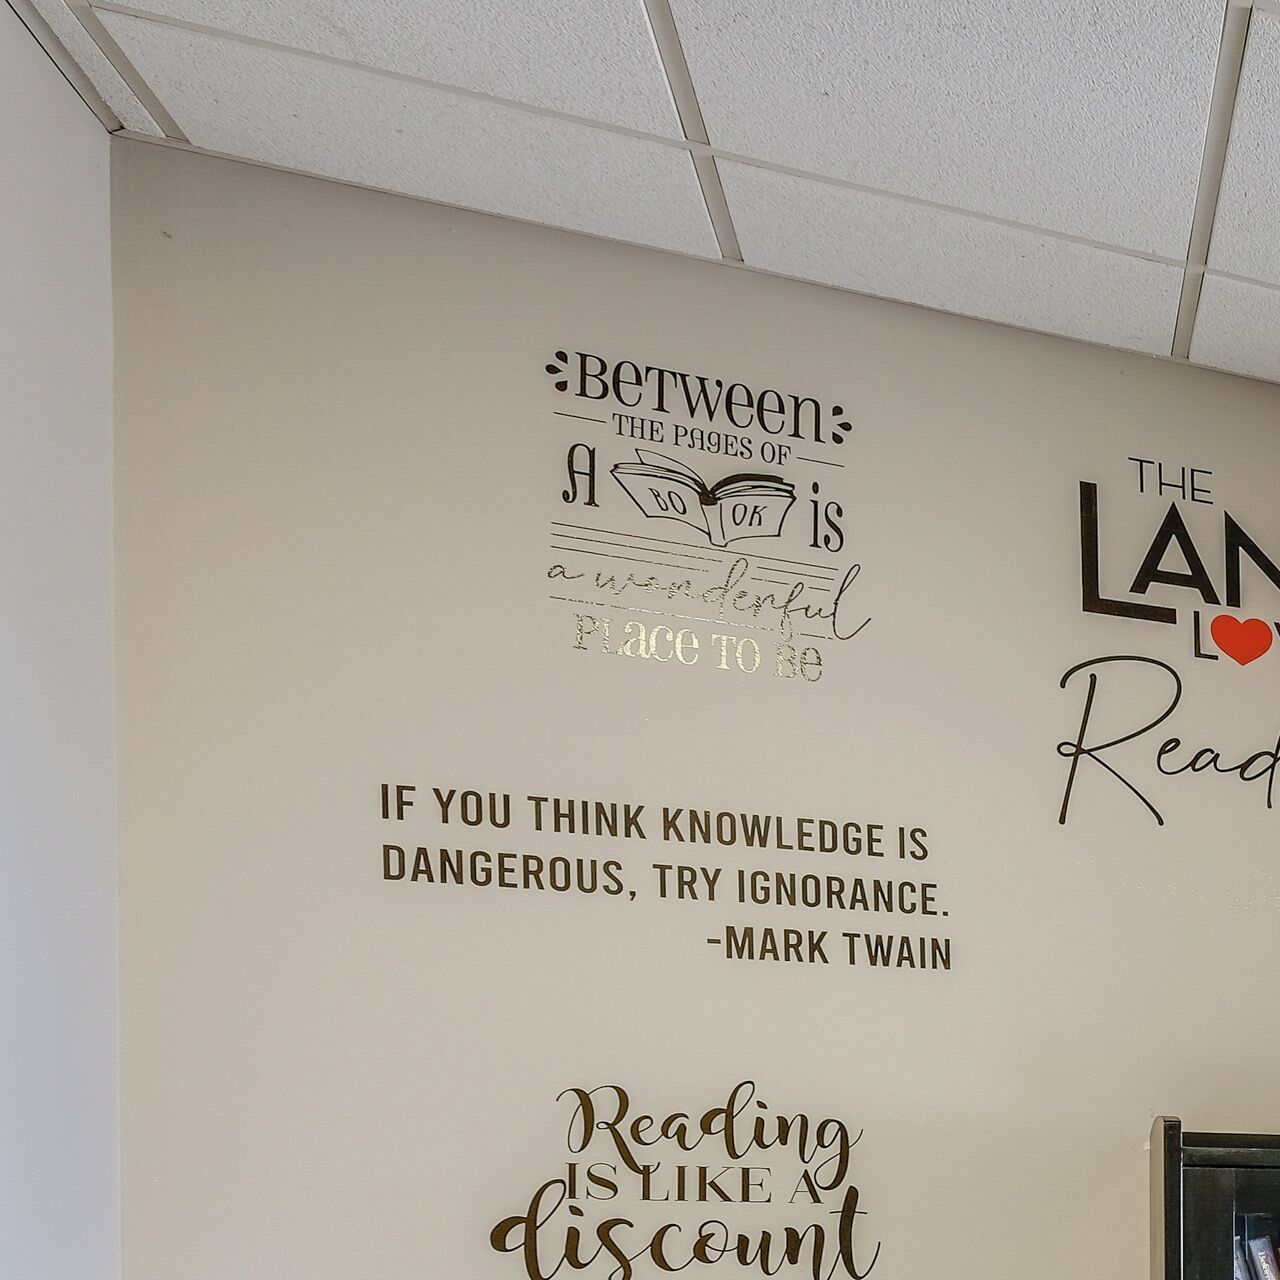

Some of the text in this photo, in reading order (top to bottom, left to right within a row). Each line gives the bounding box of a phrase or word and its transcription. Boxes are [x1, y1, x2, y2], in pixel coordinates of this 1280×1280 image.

[611, 412, 792, 467] THE PAGES OF
[561, 443, 600, 508] A
[1127, 456, 1214, 506] THE
[595, 558, 871, 640] wonderful
[380, 783, 929, 861] IF YOU THINK KNOWLEDGE IS
[382, 844, 949, 917] DANGEROUS, TRY IGNORANCE.
[841, 932, 951, 971] TWAIN
[556, 1081, 863, 1190] Reading
[566, 1163, 825, 1204] IS LIKE A
